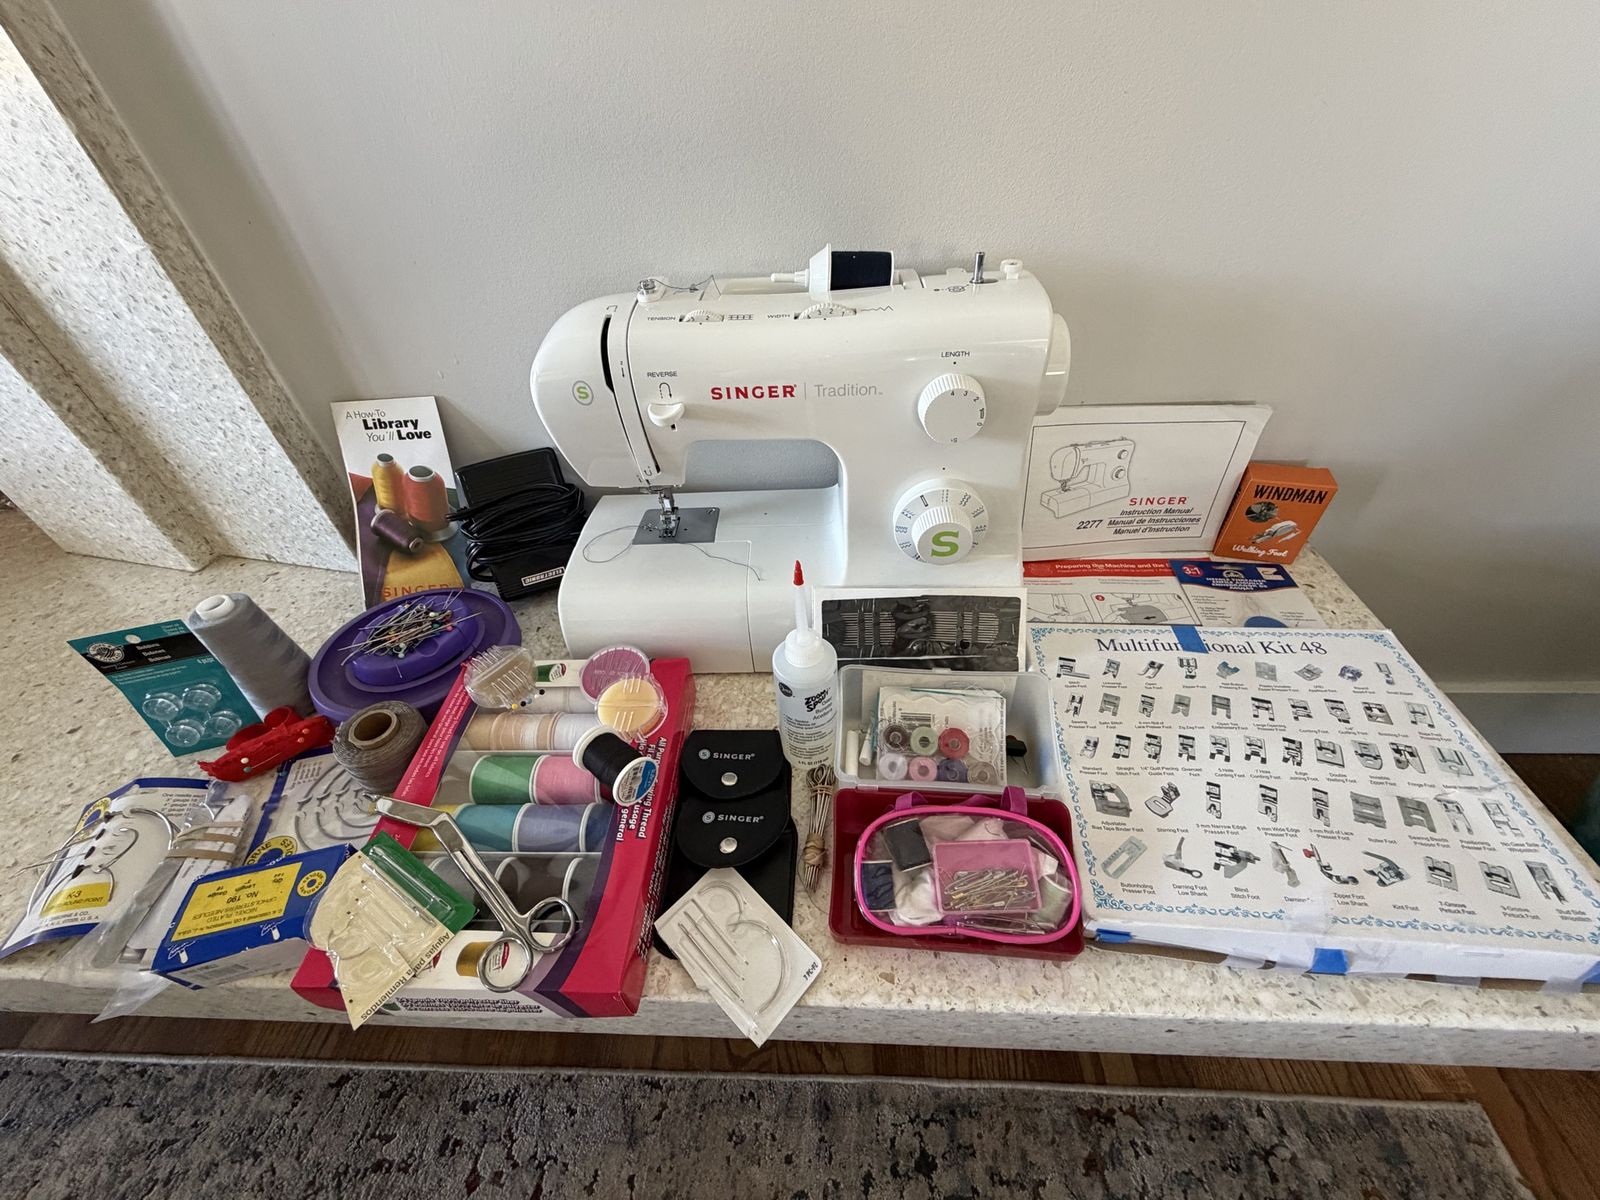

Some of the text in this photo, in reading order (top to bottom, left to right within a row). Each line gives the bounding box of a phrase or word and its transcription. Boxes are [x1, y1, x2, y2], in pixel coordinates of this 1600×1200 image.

[711, 384, 877, 400] SINGER Tradition
[346, 409, 386, 419] A How-To
[362, 418, 418, 430] Library
[366, 429, 432, 442] You'll Love
[1254, 484, 1328, 504] WINDMAN
[1129, 497, 1187, 506] SINGER
[1076, 520, 1103, 530] 2277
[931, 531, 959, 557] S
[1232, 545, 1288, 557] Walking Foot
[525, 569, 563, 583] ELECTRONIC
[1257, 640, 1296, 654] Kit
[1300, 641, 1328, 655] 48
[659, 737, 667, 747] All
[713, 752, 752, 760] SINGER
[629, 804, 641, 830] usage
[639, 808, 652, 838] Thread
[718, 814, 760, 823] SINGER
[616, 808, 629, 841] general
[425, 932, 450, 959] Agujas
[406, 958, 426, 976] para
[361, 975, 408, 1021] Remiendos
